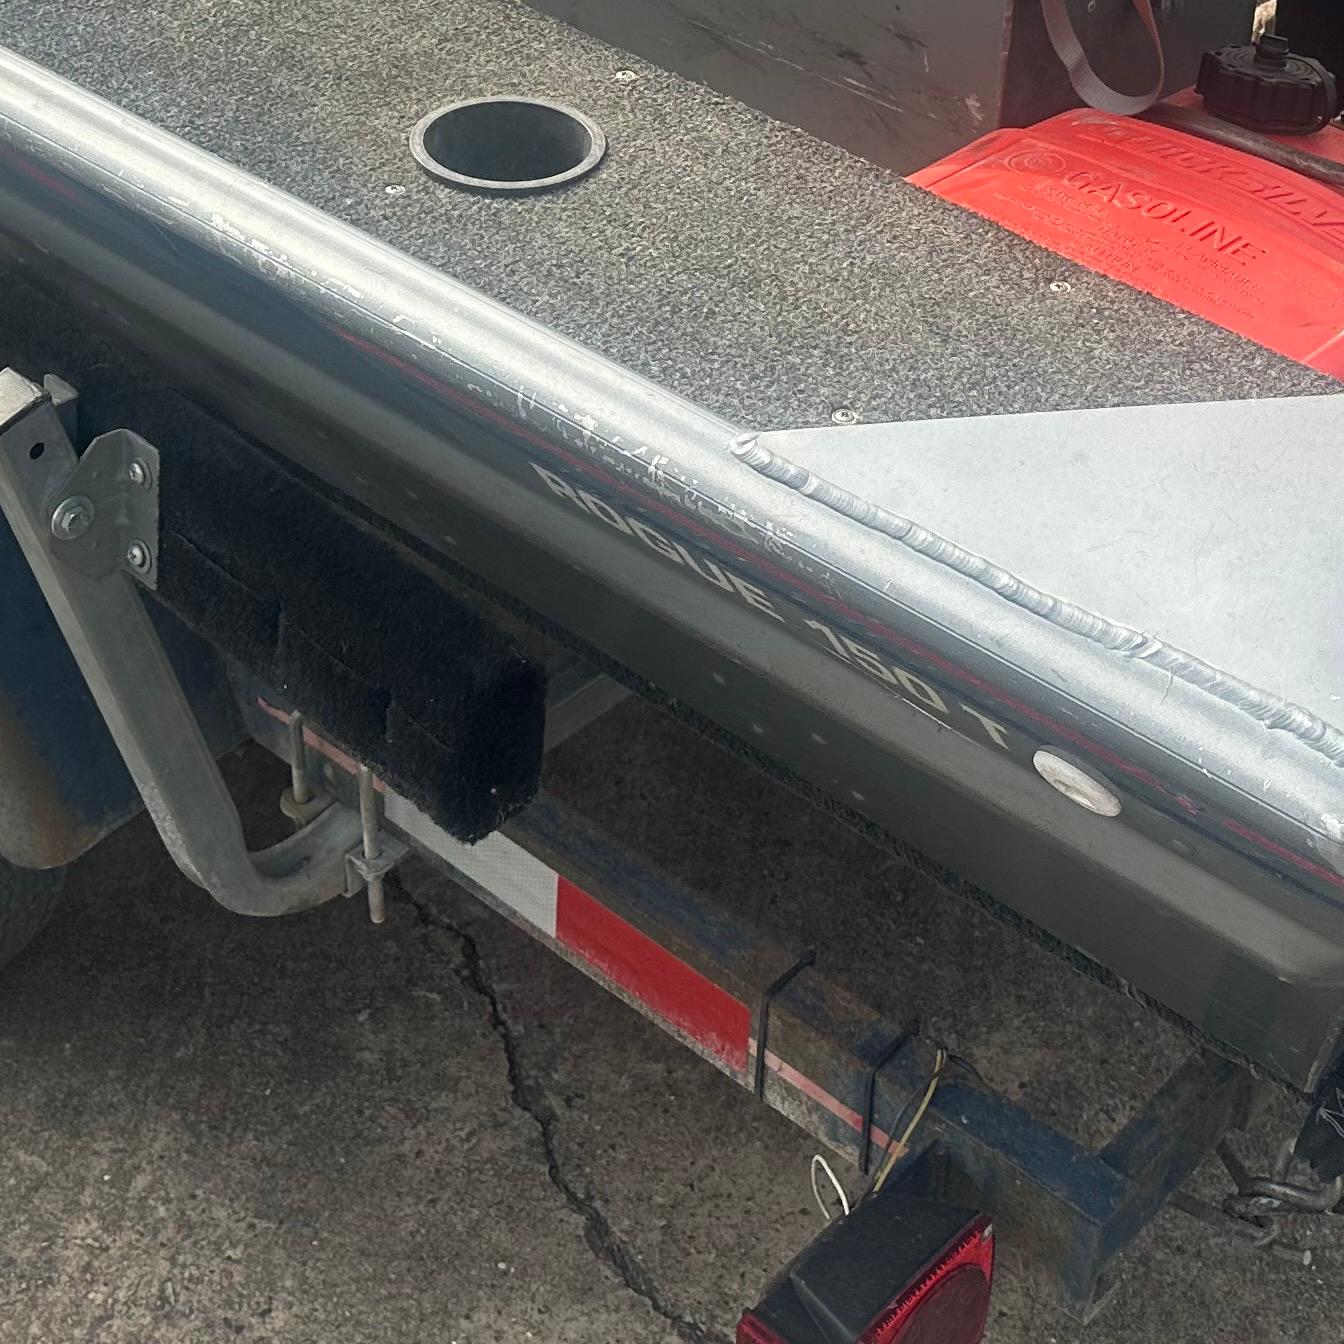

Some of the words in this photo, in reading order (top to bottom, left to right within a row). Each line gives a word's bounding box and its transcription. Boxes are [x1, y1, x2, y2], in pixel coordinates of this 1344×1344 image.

[1062, 169, 1269, 268] GASOLINE
[529, 461, 785, 623] ROGUE
[803, 618, 949, 714] 150
[960, 703, 1009, 751] T
